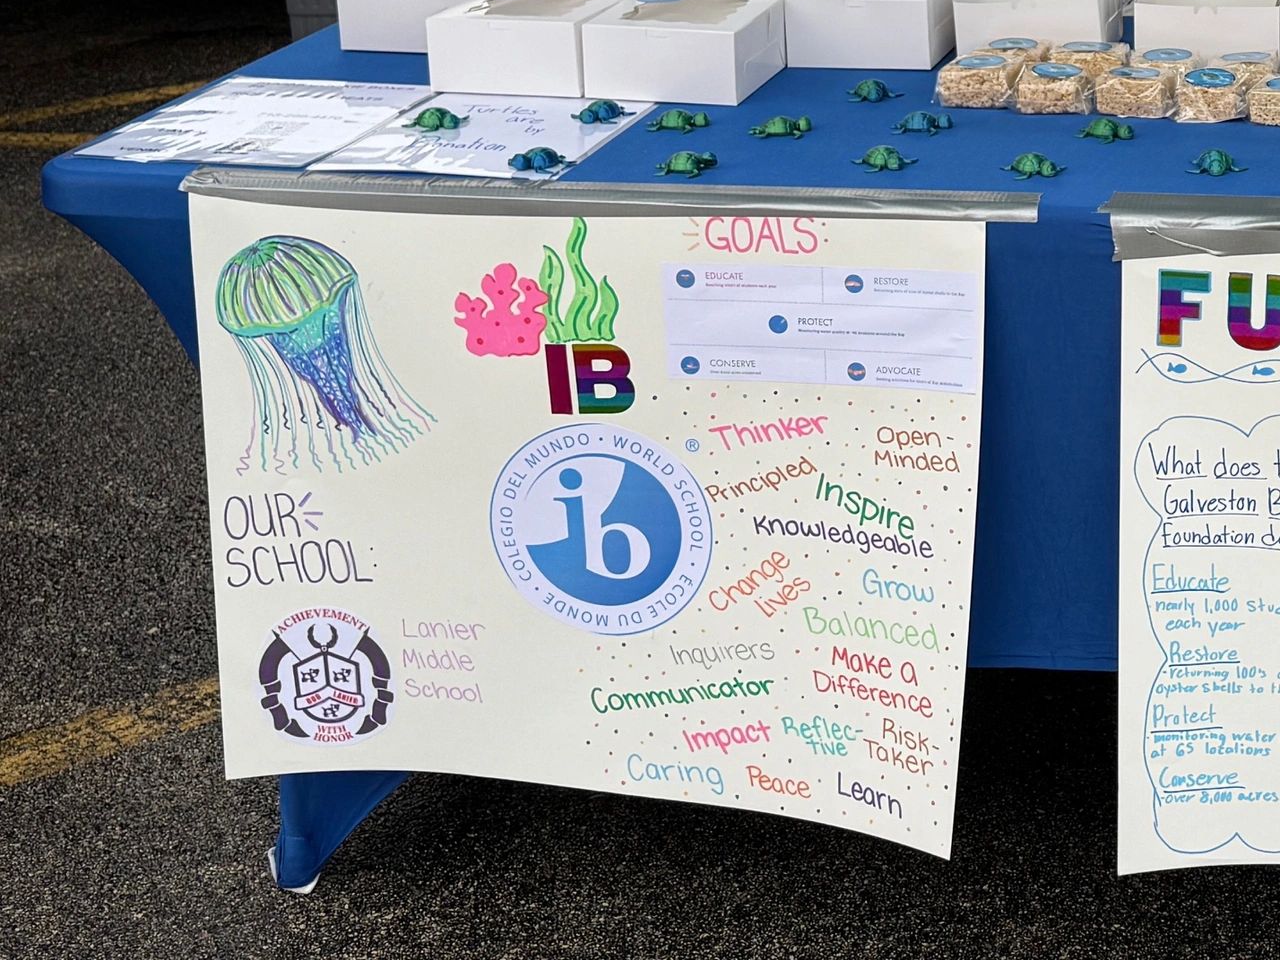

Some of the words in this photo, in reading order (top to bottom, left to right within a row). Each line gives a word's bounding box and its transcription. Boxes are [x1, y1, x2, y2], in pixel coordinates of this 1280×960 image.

[463, 104, 537, 115] Turtles
[506, 115, 544, 124] are
[524, 126, 545, 135] by
[705, 271, 744, 281] EDUCATE
[873, 277, 909, 286] RESTORE
[797, 317, 834, 327] PROTECT
[709, 358, 757, 369] CONSERVE
[875, 366, 921, 376] ADVOCATE
[544, 343, 636, 415] IB
[709, 414, 828, 451] Thinker
[524, 433, 590, 469] MUNDO
[874, 450, 960, 473] Minded
[1148, 442, 1202, 475] What
[1213, 447, 1261, 478] does
[504, 470, 527, 500] DEL
[613, 435, 674, 476] WORLD
[674, 480, 704, 552] SCHOOL
[707, 456, 817, 503] Principled
[816, 473, 915, 539] Inspire
[1163, 484, 1256, 514] Galveston
[224, 493, 302, 540] OUR
[499, 506, 532, 583] COLEGIO
[753, 515, 934, 559] Knowledgeable
[1162, 522, 1255, 545] Foundation
[709, 551, 790, 611] Change
[862, 569, 935, 603] Grow
[1152, 563, 1230, 591] Educate
[543, 592, 609, 627] MONDE
[648, 574, 694, 619] ÉCOLE
[1155, 598, 1194, 615] nearly
[278, 608, 367, 634] ACHIEVEMENT
[402, 619, 486, 640] Lanier
[618, 611, 643, 626] DU
[803, 606, 940, 653] Balanced
[1165, 617, 1201, 631] each
[1208, 620, 1245, 637] year
[403, 649, 475, 671] Middle
[669, 641, 775, 670] Inquirers
[1169, 641, 1239, 662] Restore
[831, 646, 892, 678] Make
[901, 661, 918, 686] a
[405, 679, 483, 704] School
[591, 677, 774, 713] Communicator
[813, 670, 933, 718] Difference
[1155, 684, 1197, 698] oyster
[1203, 682, 1243, 694] shells
[1250, 684, 1263, 693] to
[317, 725, 346, 734] WITH
[1153, 703, 1216, 728] Protect
[313, 731, 354, 743] HONOR
[683, 720, 771, 754] Impact
[1151, 744, 1166, 758] at
[1205, 743, 1271, 756] locations
[1153, 731, 1226, 745] monitoring
[1232, 732, 1276, 743] water
[863, 739, 934, 776] Taker
[627, 753, 724, 795] Caring
[745, 765, 811, 799] Peace
[1160, 767, 1239, 788] Conserve
[837, 771, 902, 818] Learn
[1238, 792, 1279, 802] acres
